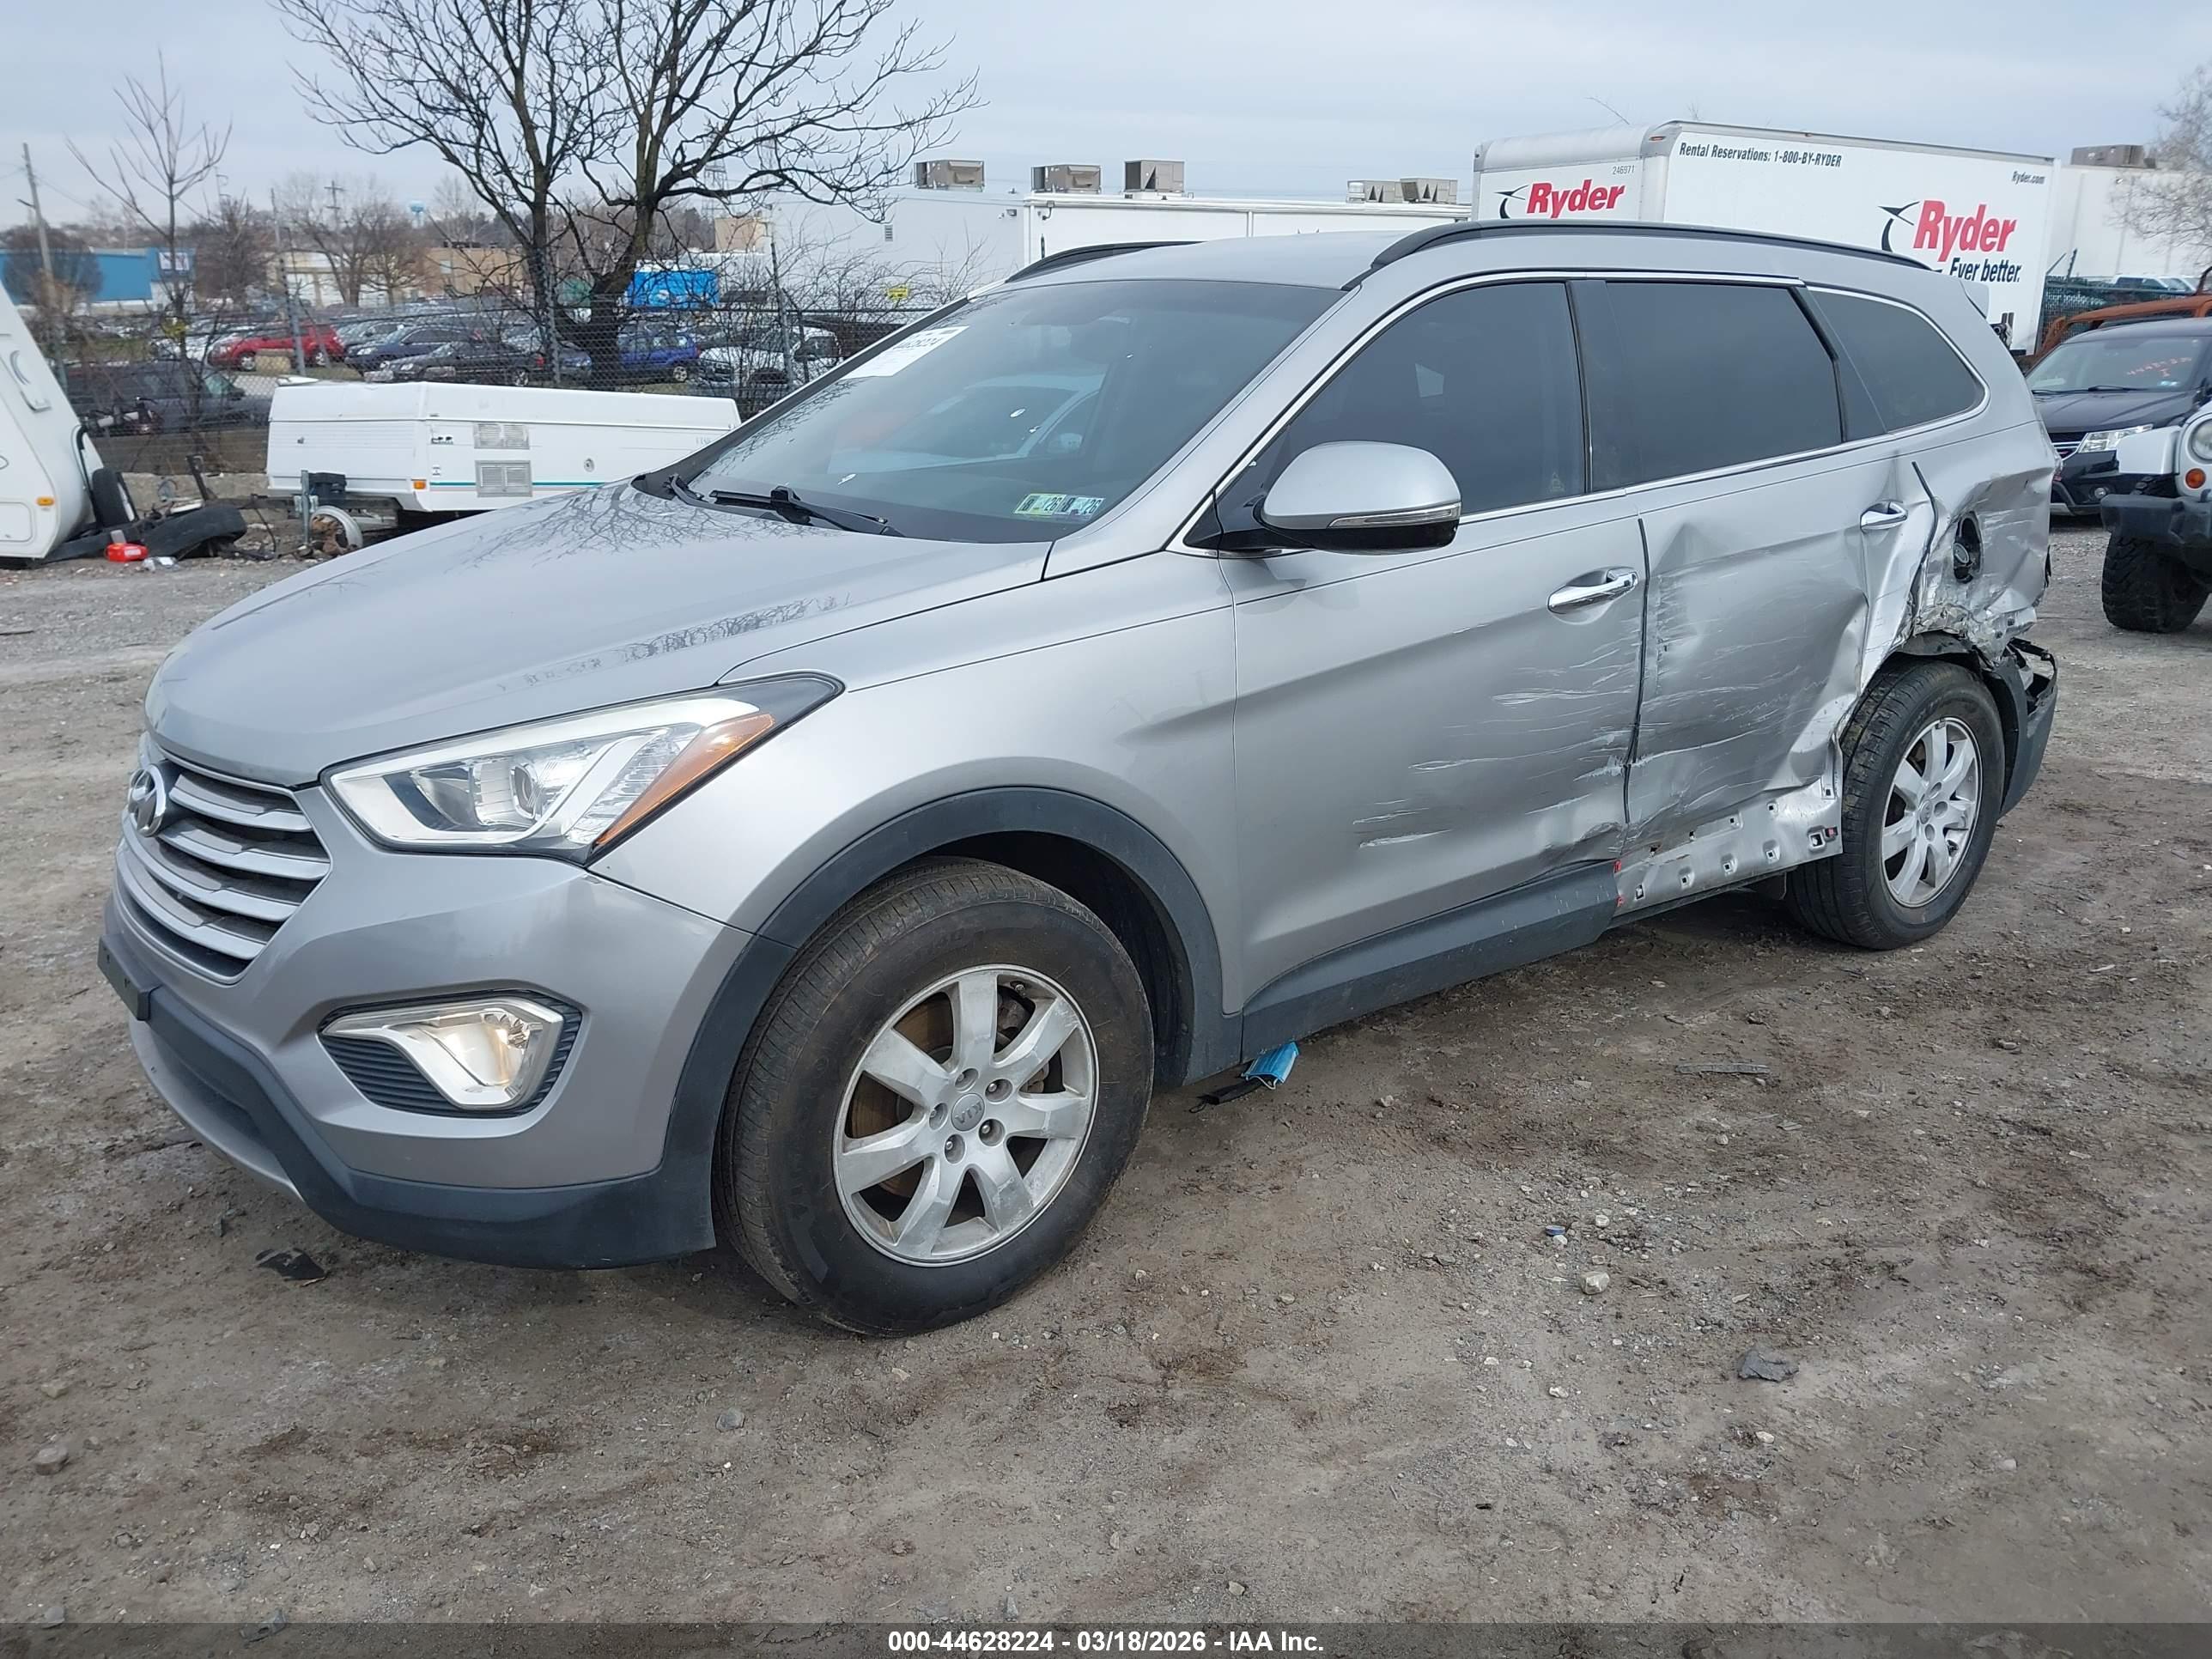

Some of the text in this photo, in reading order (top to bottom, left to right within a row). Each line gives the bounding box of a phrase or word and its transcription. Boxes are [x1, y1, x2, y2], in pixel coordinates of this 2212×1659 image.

[1679, 142, 1842, 167] Rental Reservations: 1-800-BY-RYDER
[1612, 164, 1635, 175] 246971
[2012, 171, 2045, 185] Ryder.com
[1526, 179, 1626, 219] Ryder
[1913, 200, 2017, 262] Ryder
[1949, 257, 2022, 283] Ever better.
[953, 1099, 982, 1124] KIA
